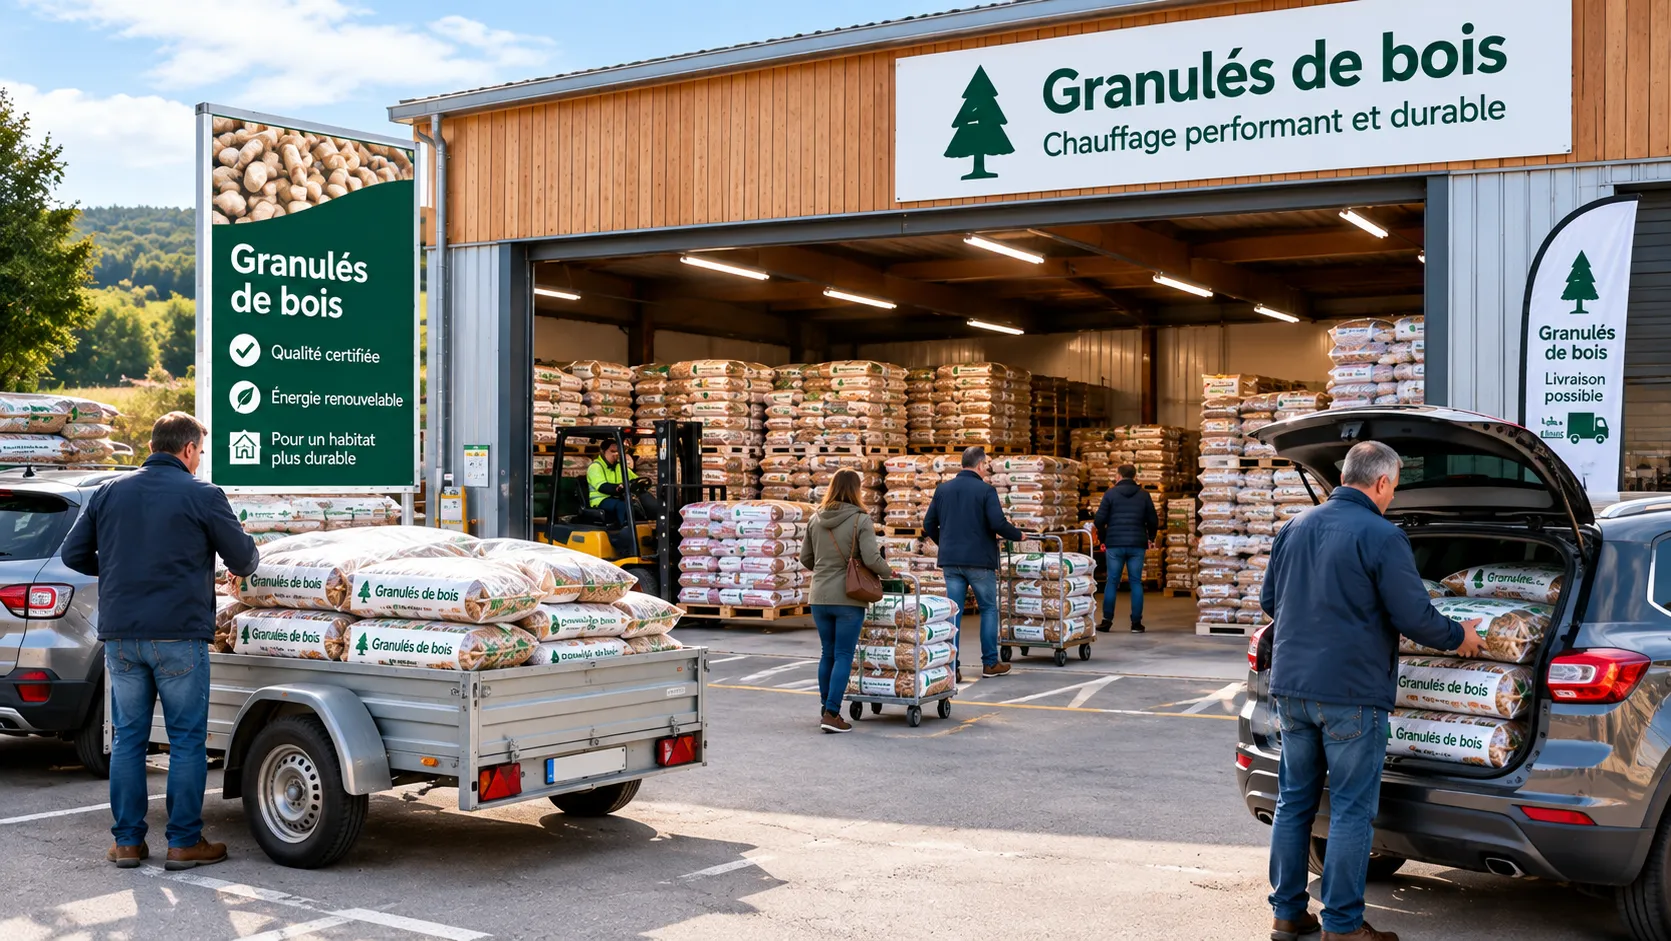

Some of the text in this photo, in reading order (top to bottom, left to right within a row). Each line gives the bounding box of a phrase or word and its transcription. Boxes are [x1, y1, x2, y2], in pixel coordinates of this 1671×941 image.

[1043, 22, 1507, 115] Granulés de bois
[1044, 94, 1506, 157] Chauffage performant et durable
[231, 243, 368, 283] Granulés
[231, 282, 343, 318] de bois
[1539, 324, 1615, 341] Granulés
[271, 344, 380, 363] Qualité certifiée
[1545, 344, 1607, 360] de bois
[1545, 372, 1605, 385] Livraison
[272, 386, 403, 408] Énergie renouvelable
[1545, 389, 1603, 405] possible
[272, 432, 376, 446] Pour un habitat
[272, 450, 356, 468] plus durable
[250, 573, 322, 589] Granulés de bois
[375, 584, 459, 601] Granulés de bois
[289, 629, 301, 642] de
[302, 631, 320, 643] bois
[372, 637, 452, 655] Granulés de bois
[1447, 680, 1461, 693] de
[1464, 681, 1488, 696] bois
[1443, 733, 1457, 746] de
[1459, 734, 1482, 749] bois
